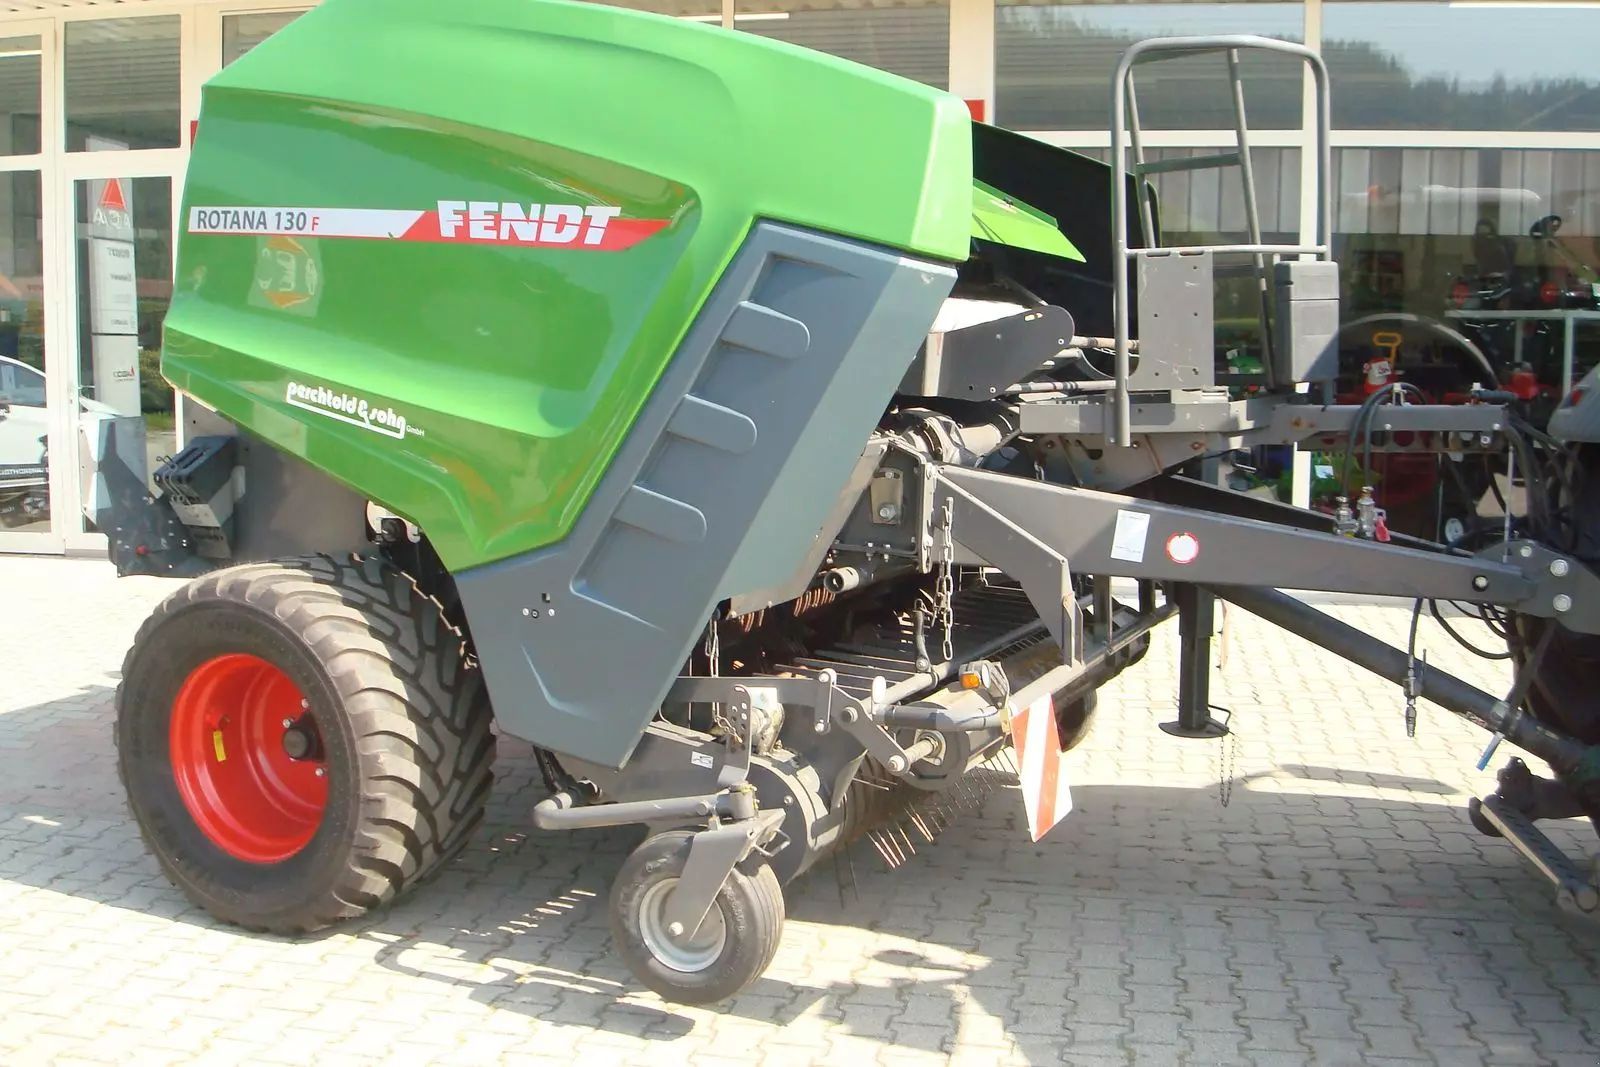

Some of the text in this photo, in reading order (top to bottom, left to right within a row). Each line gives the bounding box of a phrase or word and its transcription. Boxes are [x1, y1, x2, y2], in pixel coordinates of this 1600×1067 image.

[197, 210, 320, 231] ROTANA 130 F
[437, 200, 621, 245] FENDT
[286, 381, 358, 415] perchtold
[369, 406, 407, 435] sohn
[406, 424, 425, 437] GmbH
